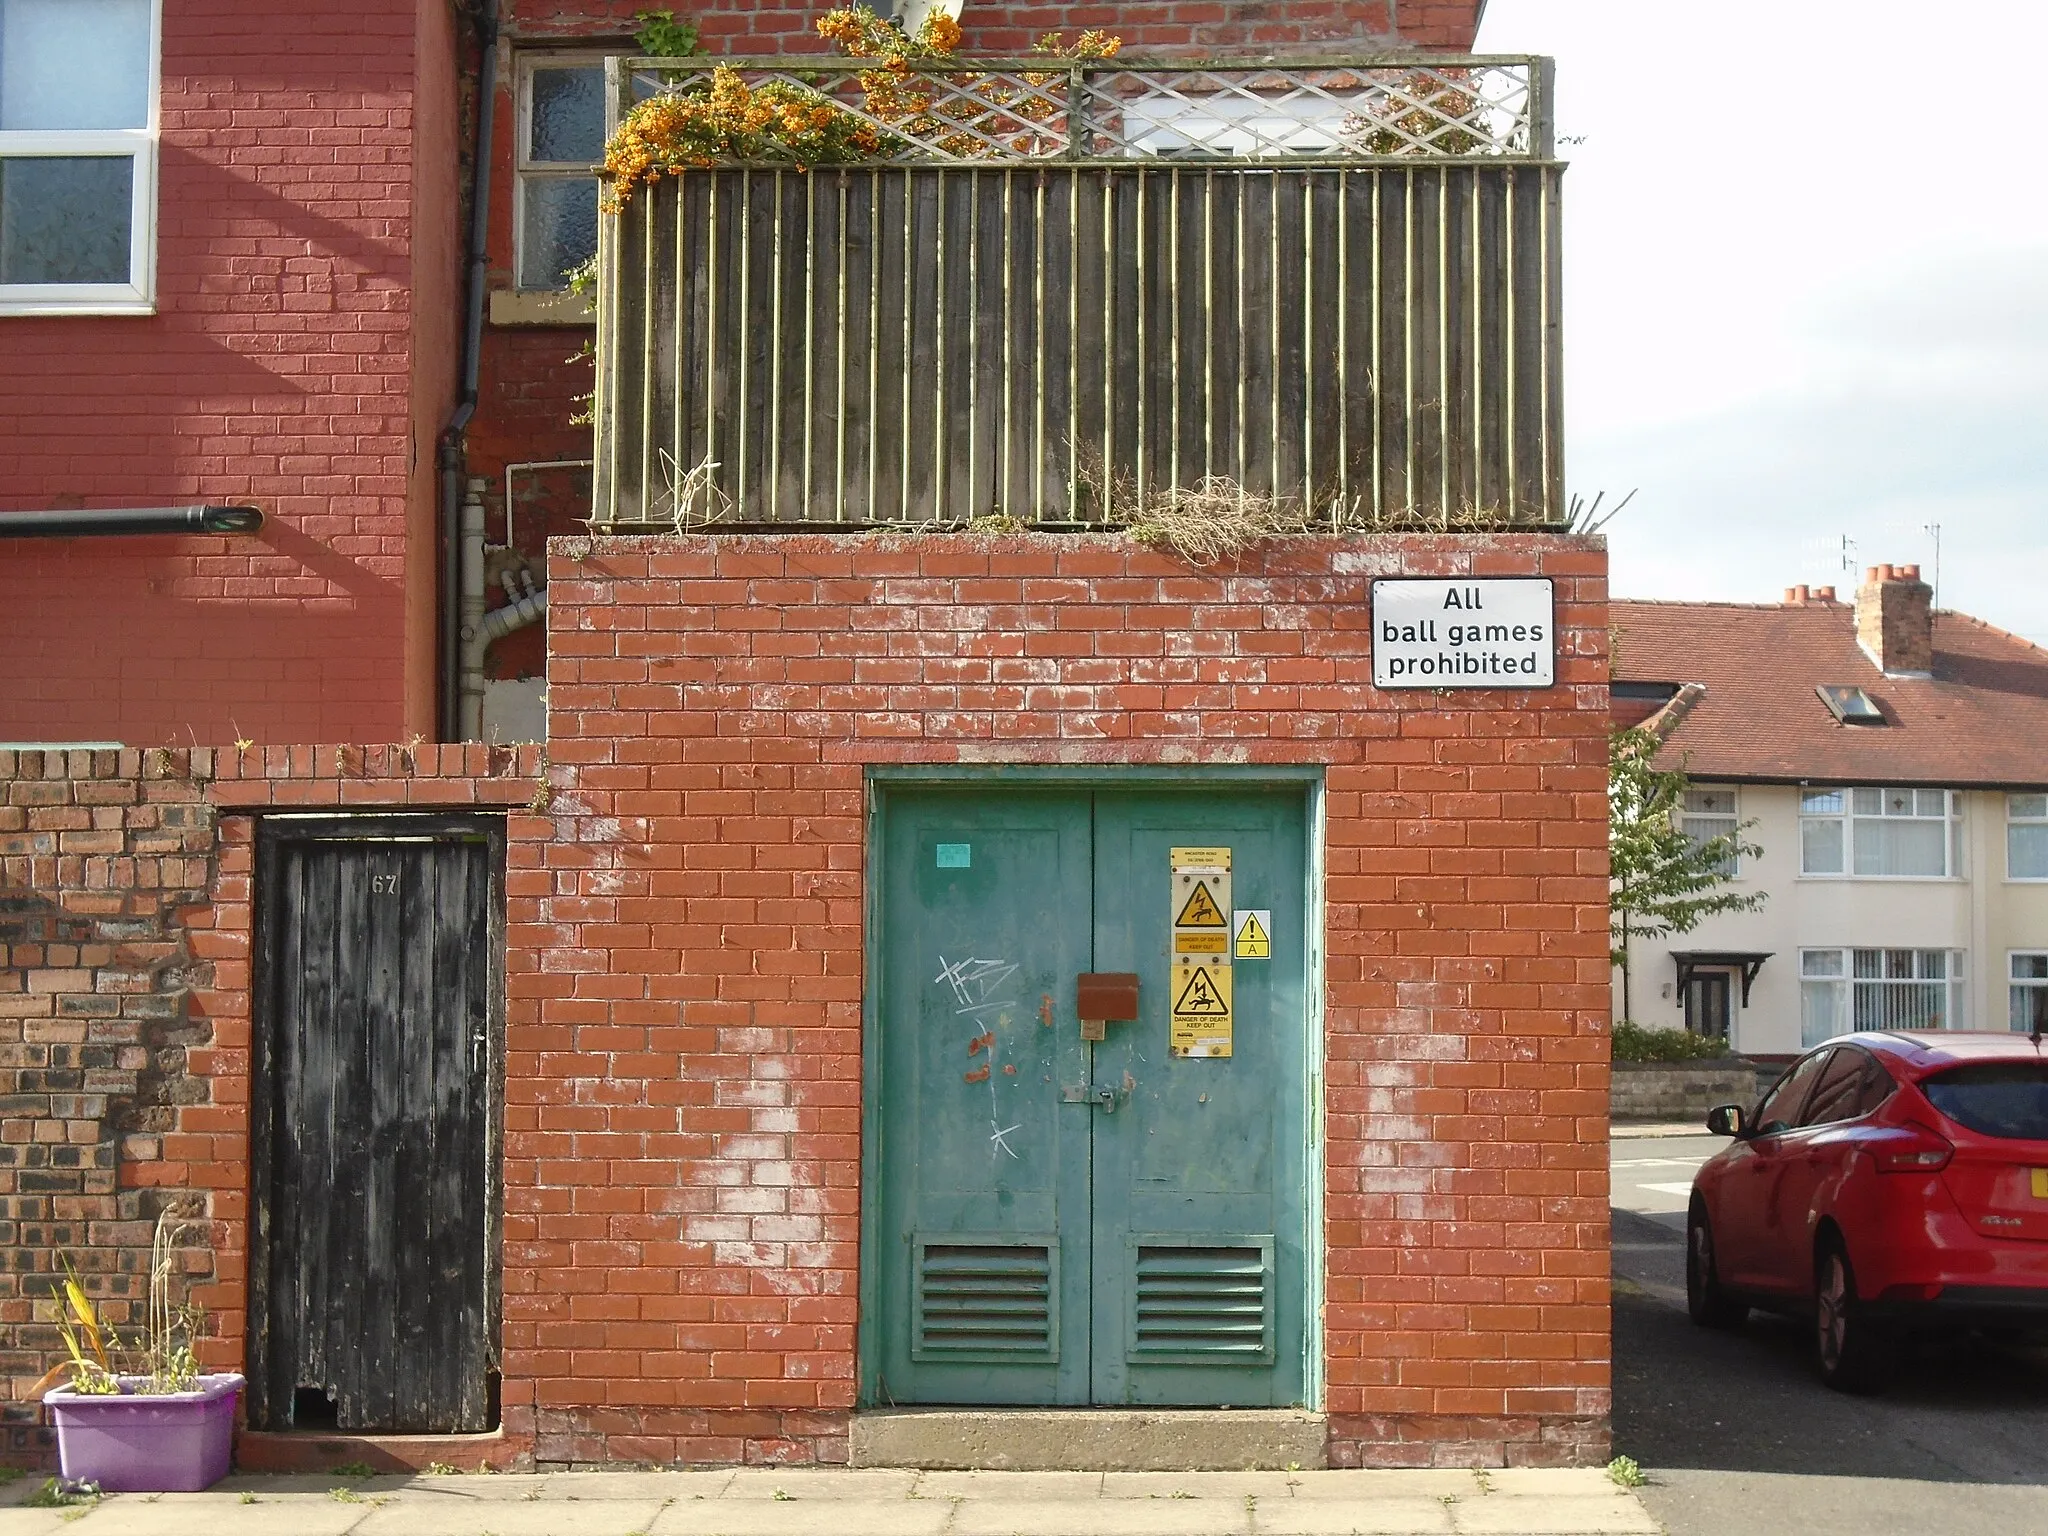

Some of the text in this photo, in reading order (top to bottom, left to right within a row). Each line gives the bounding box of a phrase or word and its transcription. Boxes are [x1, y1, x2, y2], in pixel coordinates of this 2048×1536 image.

[1443, 587, 1483, 610] All
[1383, 620, 1544, 647] ball games
[1389, 651, 1537, 679] prohibited
[372, 874, 397, 895] 67
[1248, 944, 1257, 954] A
